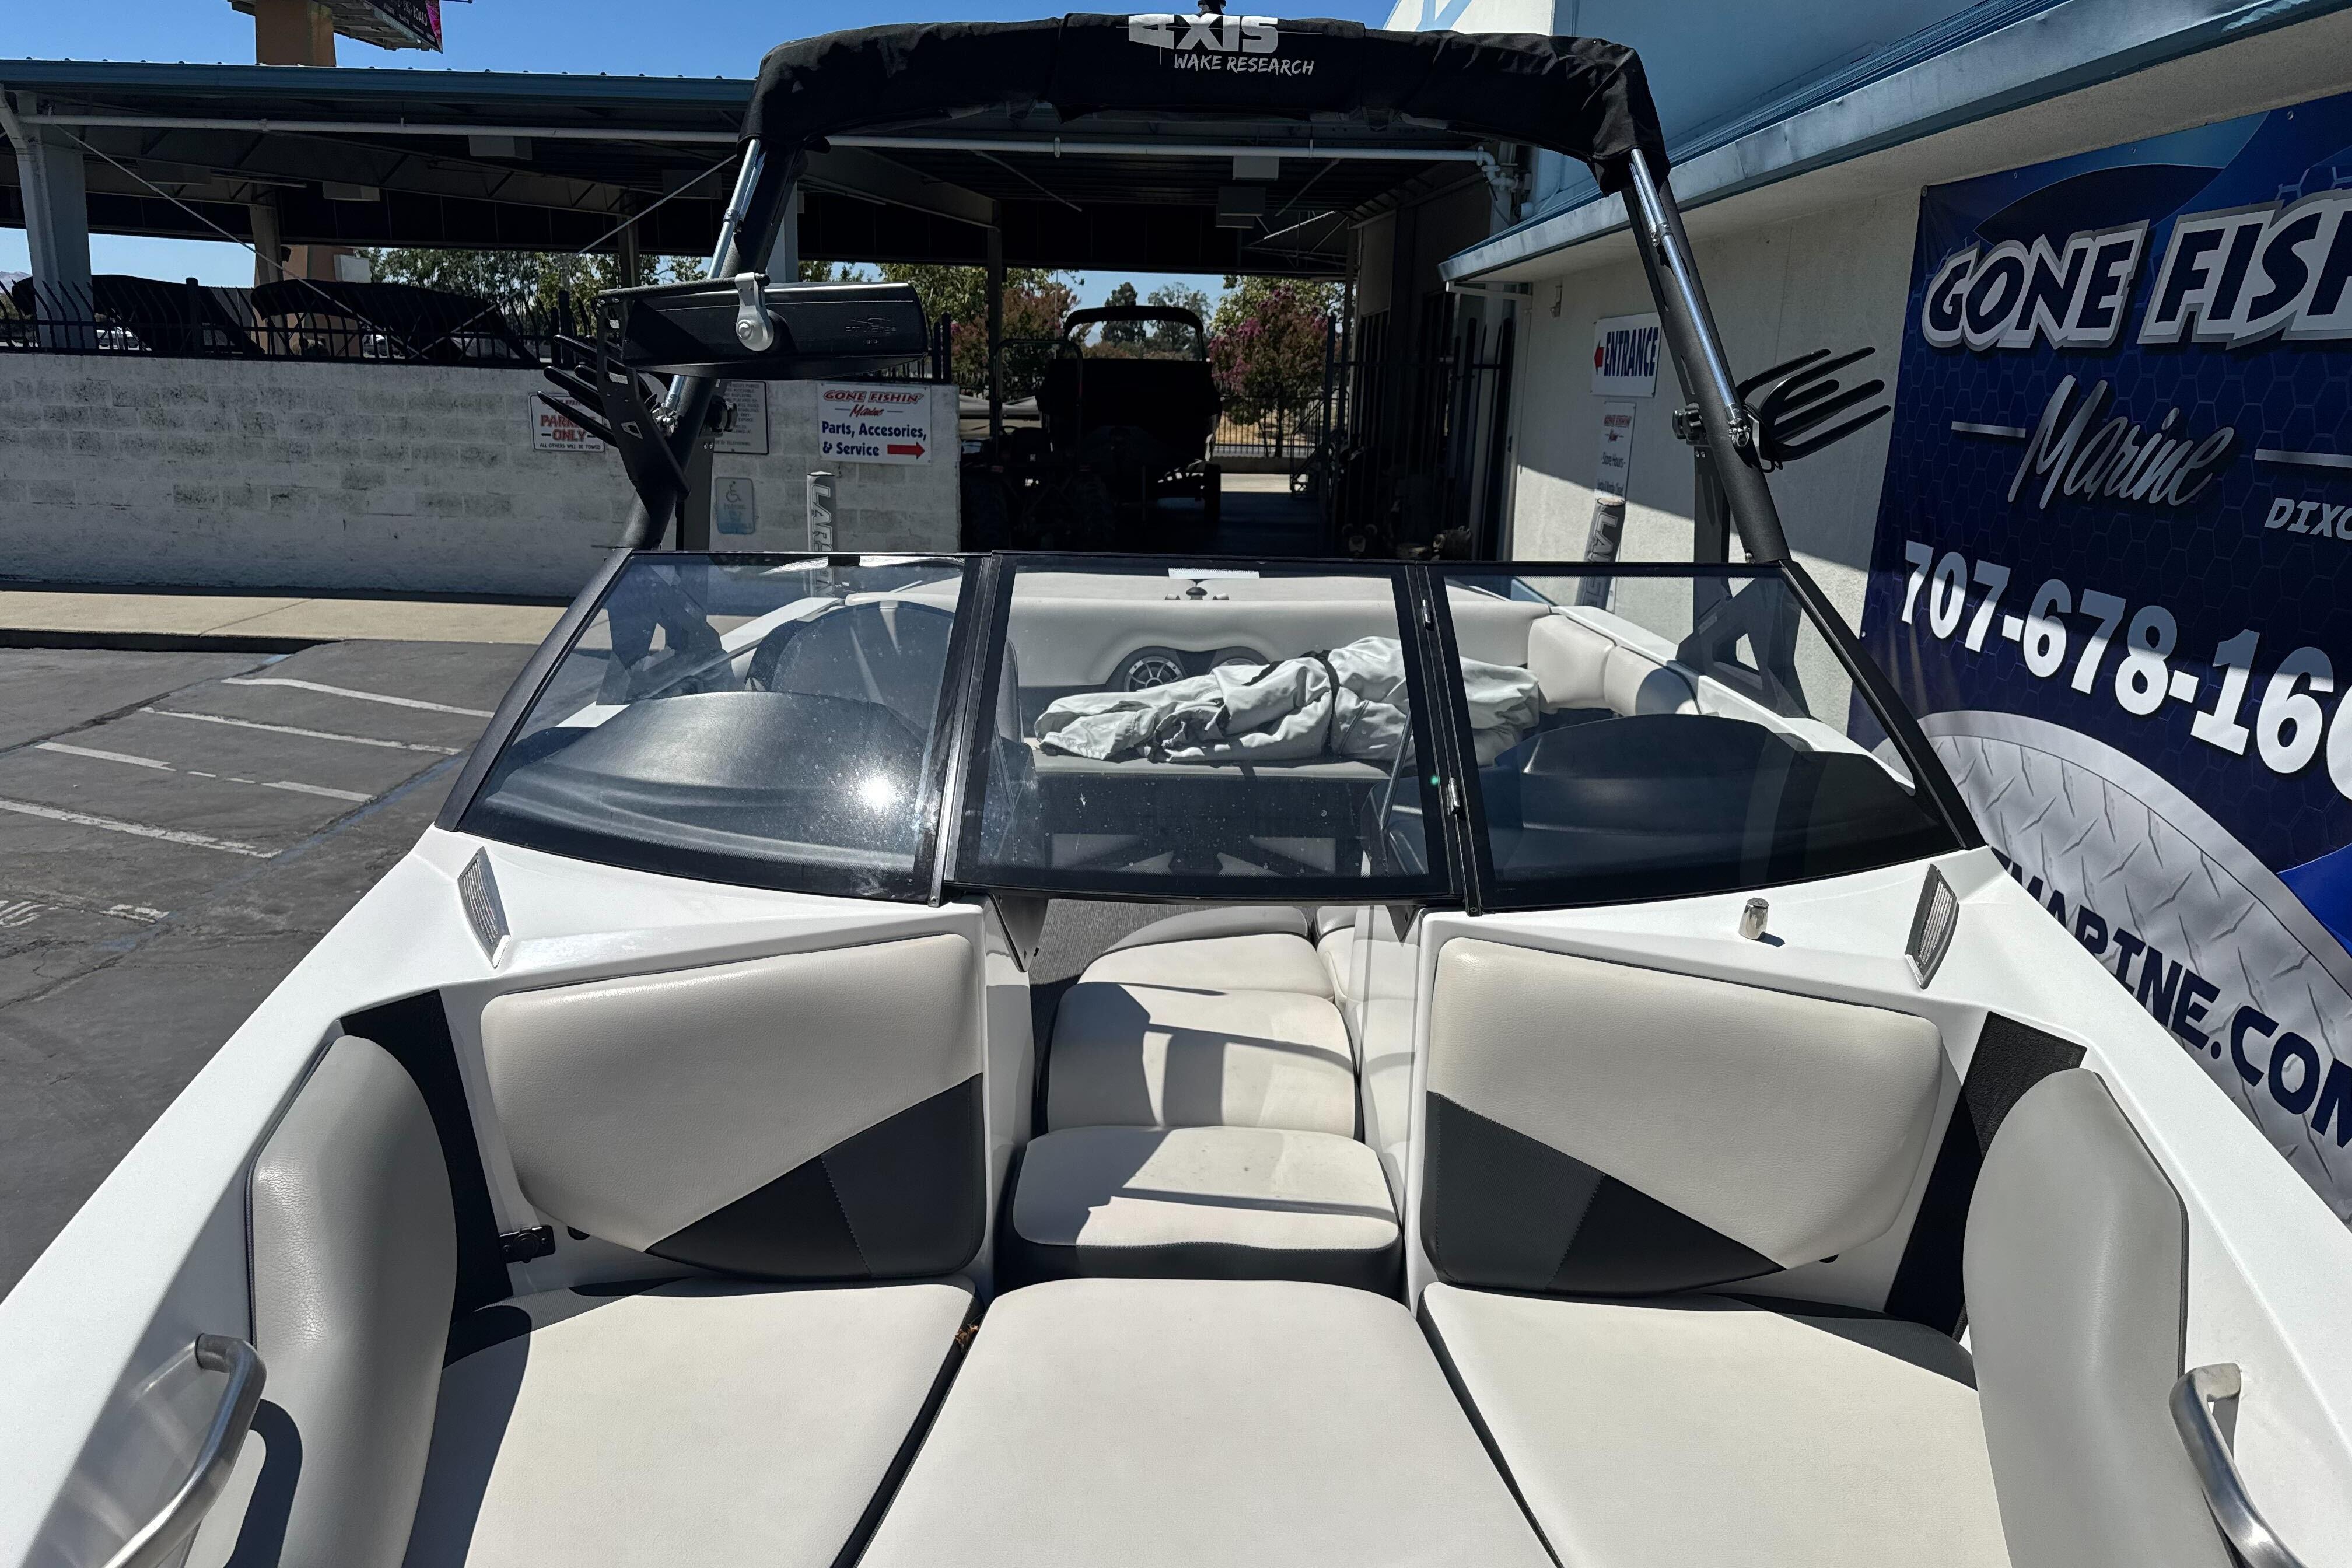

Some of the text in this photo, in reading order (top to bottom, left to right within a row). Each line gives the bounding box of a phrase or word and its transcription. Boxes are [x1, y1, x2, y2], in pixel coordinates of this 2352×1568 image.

[1174, 53, 1314, 76] WAKE RESEARCH
[1922, 220, 2149, 351] GONE
[1604, 327, 1658, 377] ENTRANCE
[823, 390, 925, 404] GONE FISHIN'
[552, 429, 587, 442] ONLY
[822, 420, 927, 442] Parts, Accesories,
[2007, 373, 2234, 510] Marine
[822, 440, 880, 456] & Service
